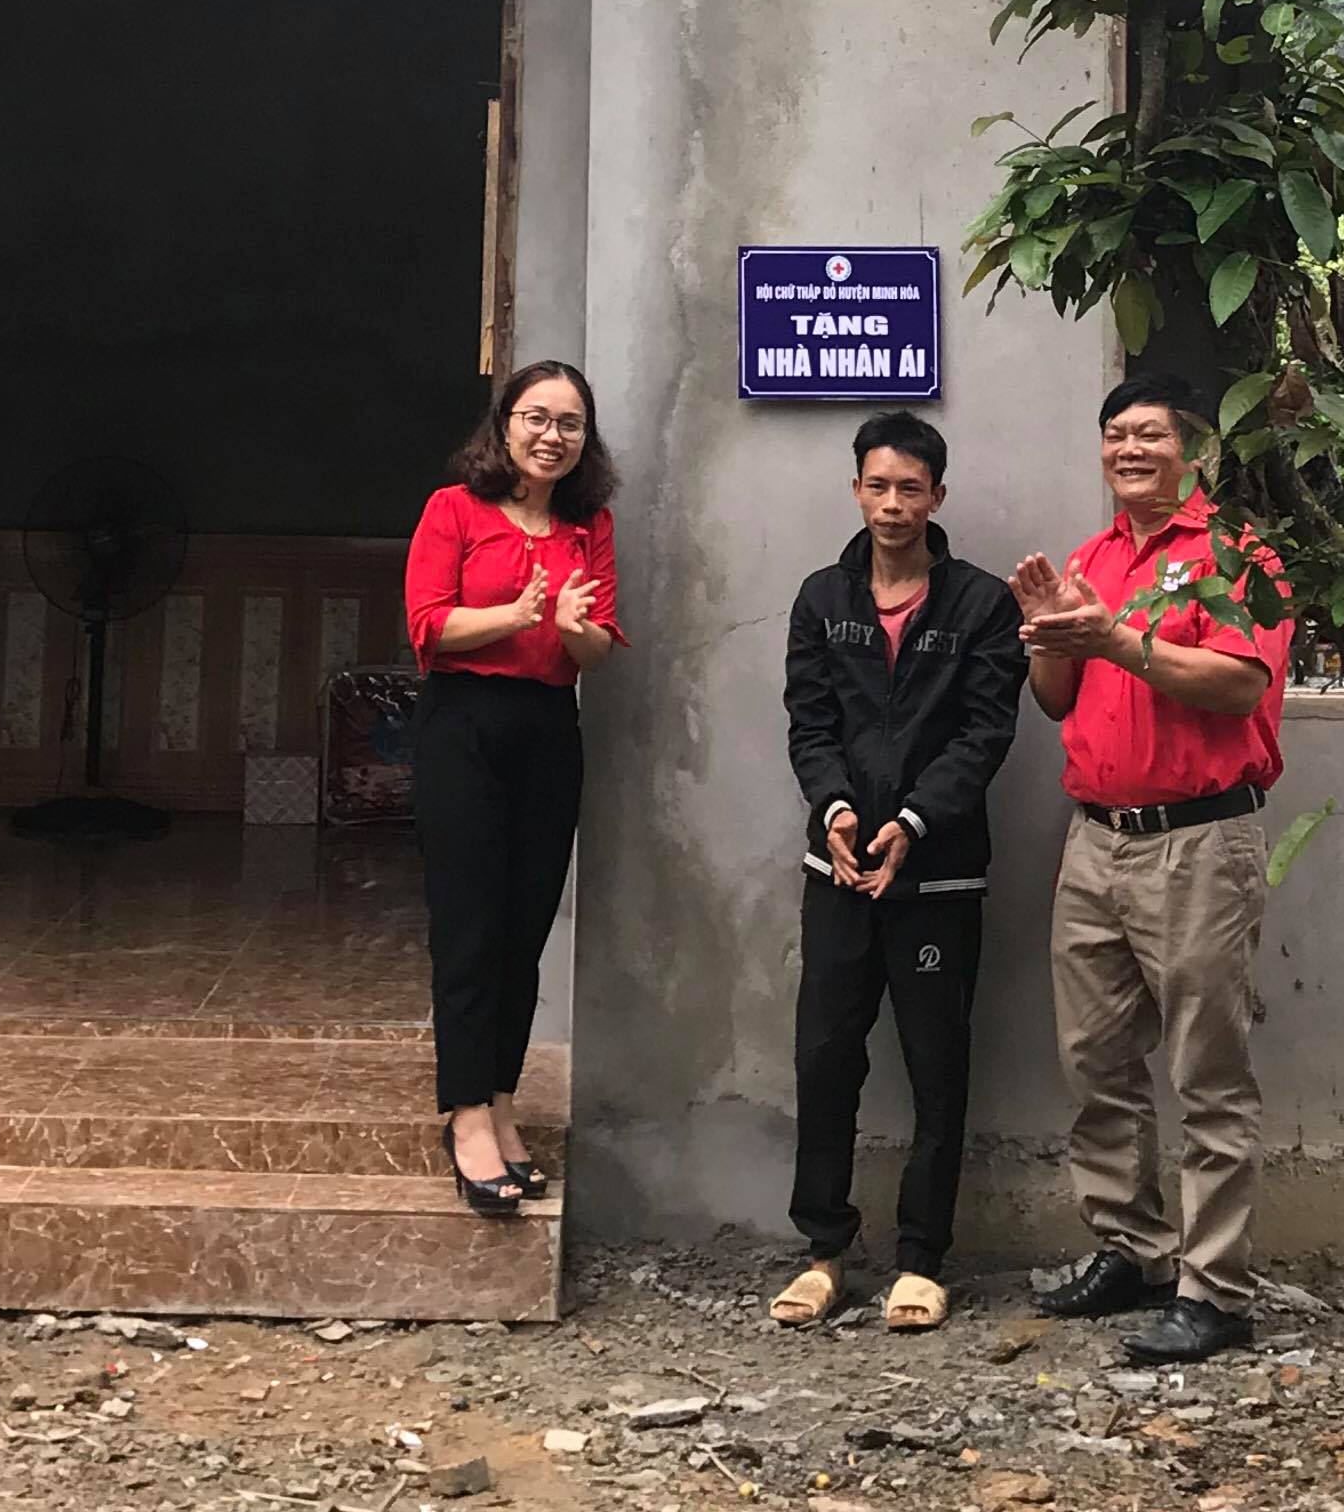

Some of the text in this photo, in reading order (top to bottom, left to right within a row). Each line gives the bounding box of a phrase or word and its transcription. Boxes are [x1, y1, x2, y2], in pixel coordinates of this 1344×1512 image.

[756, 283, 773, 302] HỘI
[775, 283, 795, 300] CHỮ
[796, 283, 821, 303] THẬP
[838, 284, 871, 303] HUYỆN
[872, 286, 898, 300] MINH
[899, 284, 921, 300] HÓA
[790, 312, 889, 339] TẶNG
[757, 343, 926, 378] NHÀ NHÂN ÁI
